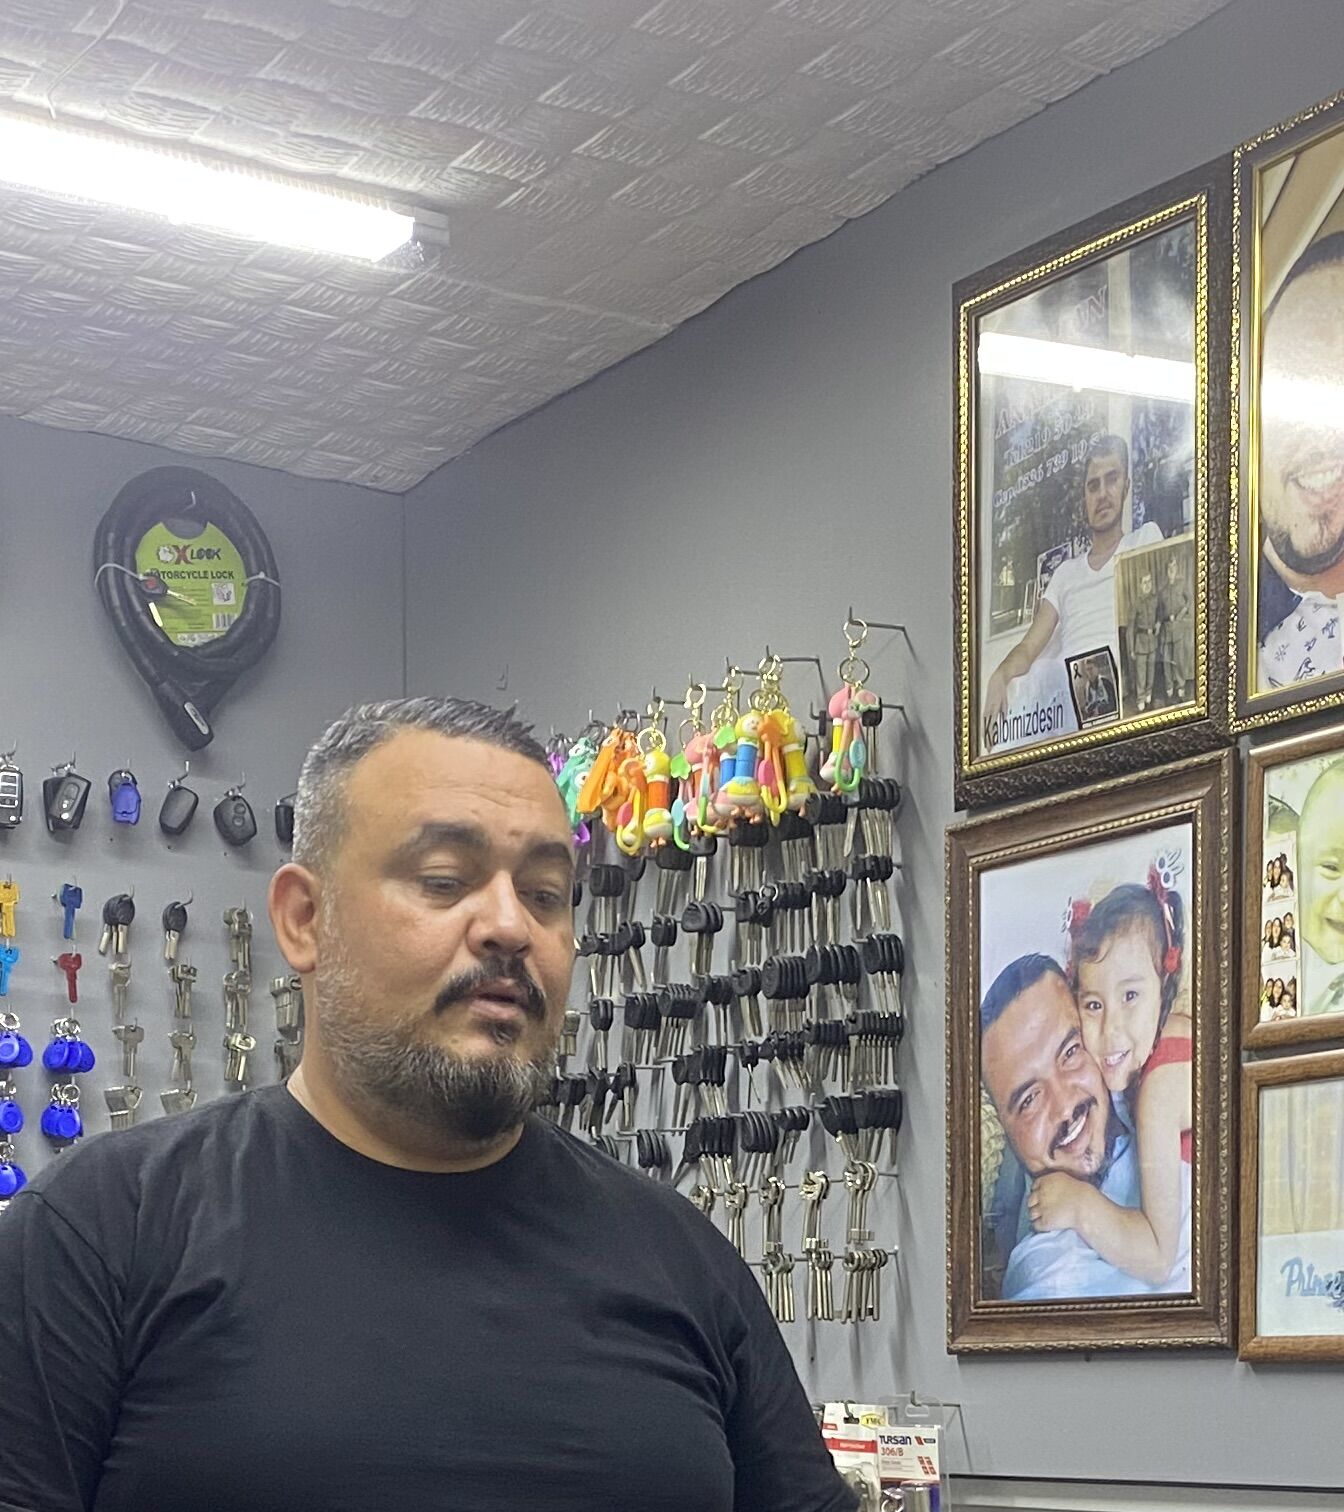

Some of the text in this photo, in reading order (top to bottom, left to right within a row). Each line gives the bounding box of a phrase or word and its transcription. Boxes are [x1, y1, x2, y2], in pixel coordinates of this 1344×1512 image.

[160, 570, 235, 580] TORCYCLE LOCK
[983, 697, 1064, 748] Kalbimizdesin
